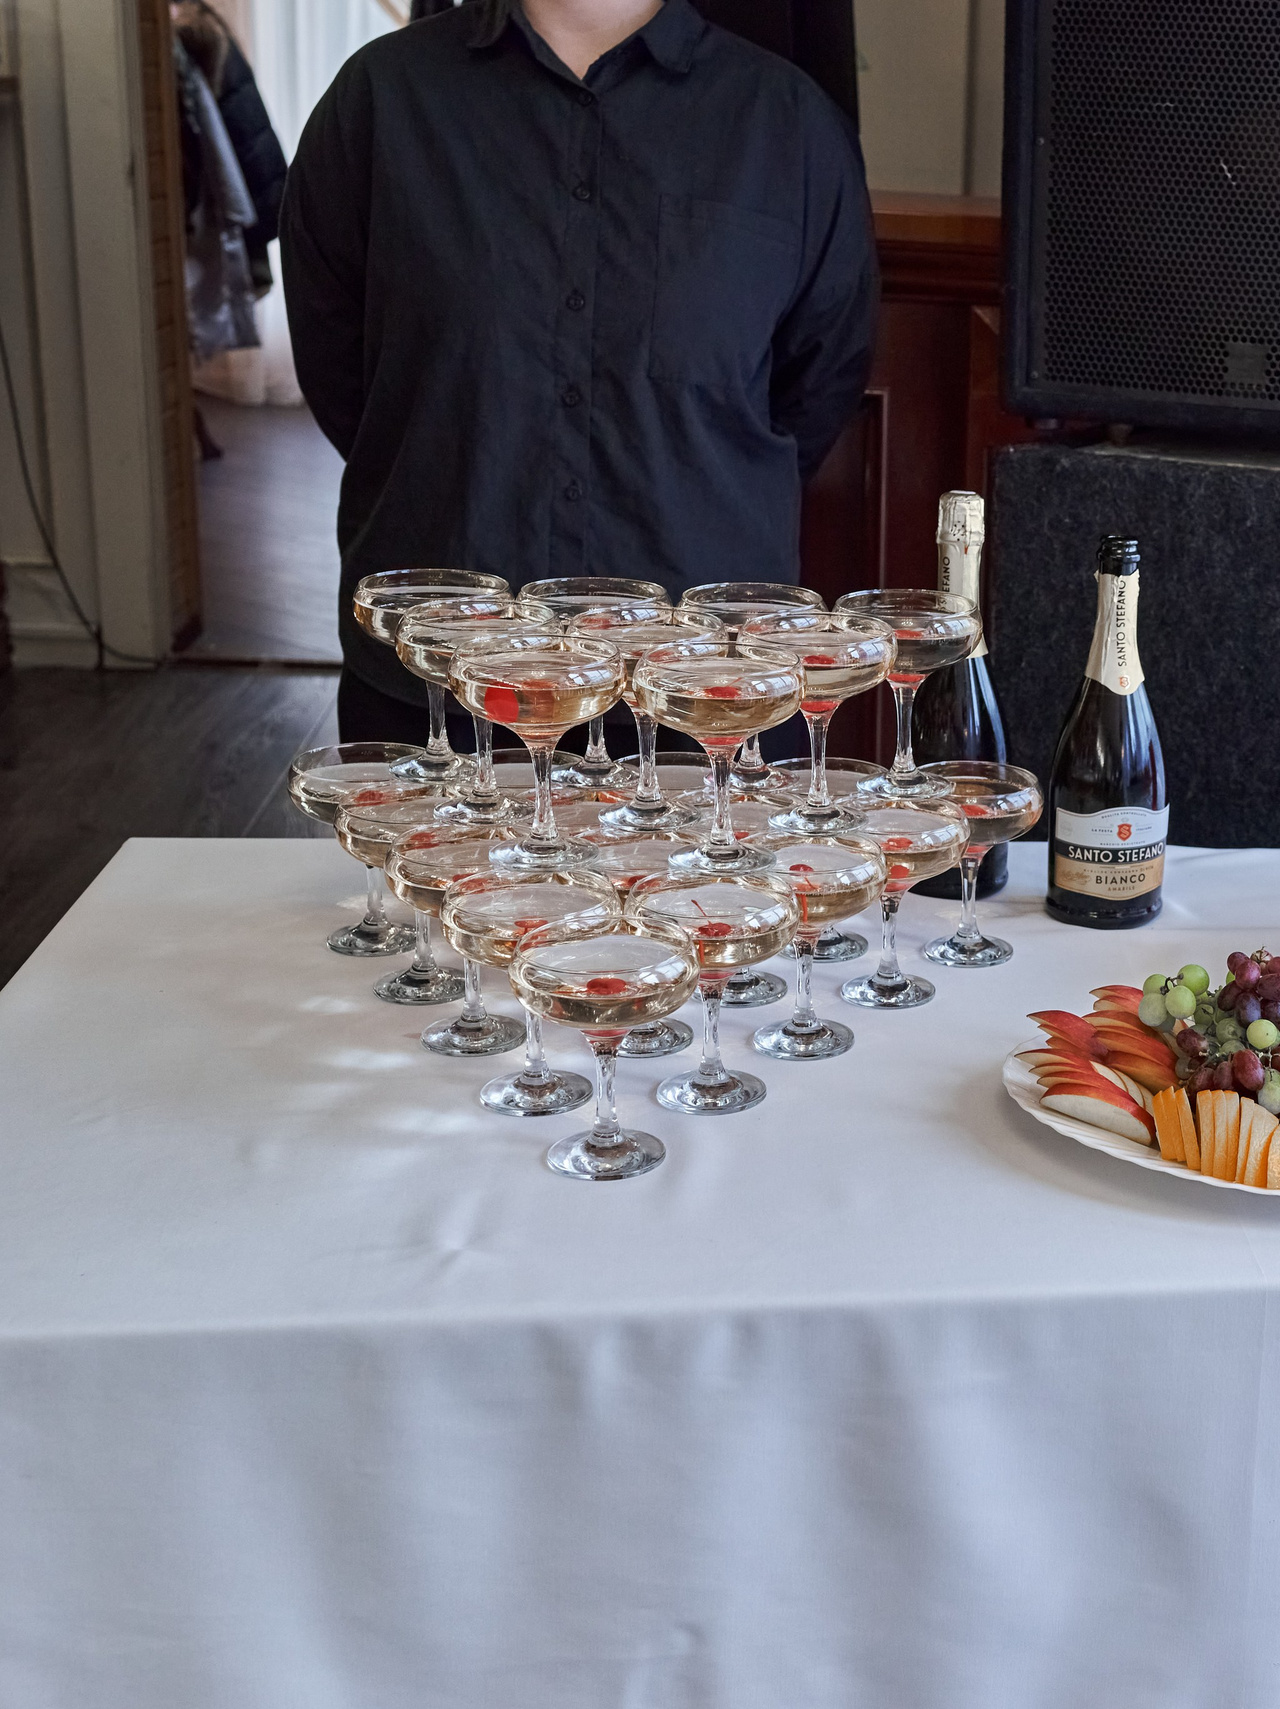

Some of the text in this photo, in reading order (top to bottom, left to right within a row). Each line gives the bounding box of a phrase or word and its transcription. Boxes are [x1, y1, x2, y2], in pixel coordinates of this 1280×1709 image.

[1116, 579, 1127, 628] STEFANO
[1116, 631, 1127, 667] SANTO
[1068, 841, 1164, 863] SANTO STEFANO
[1095, 873, 1146, 885] BIANCO
